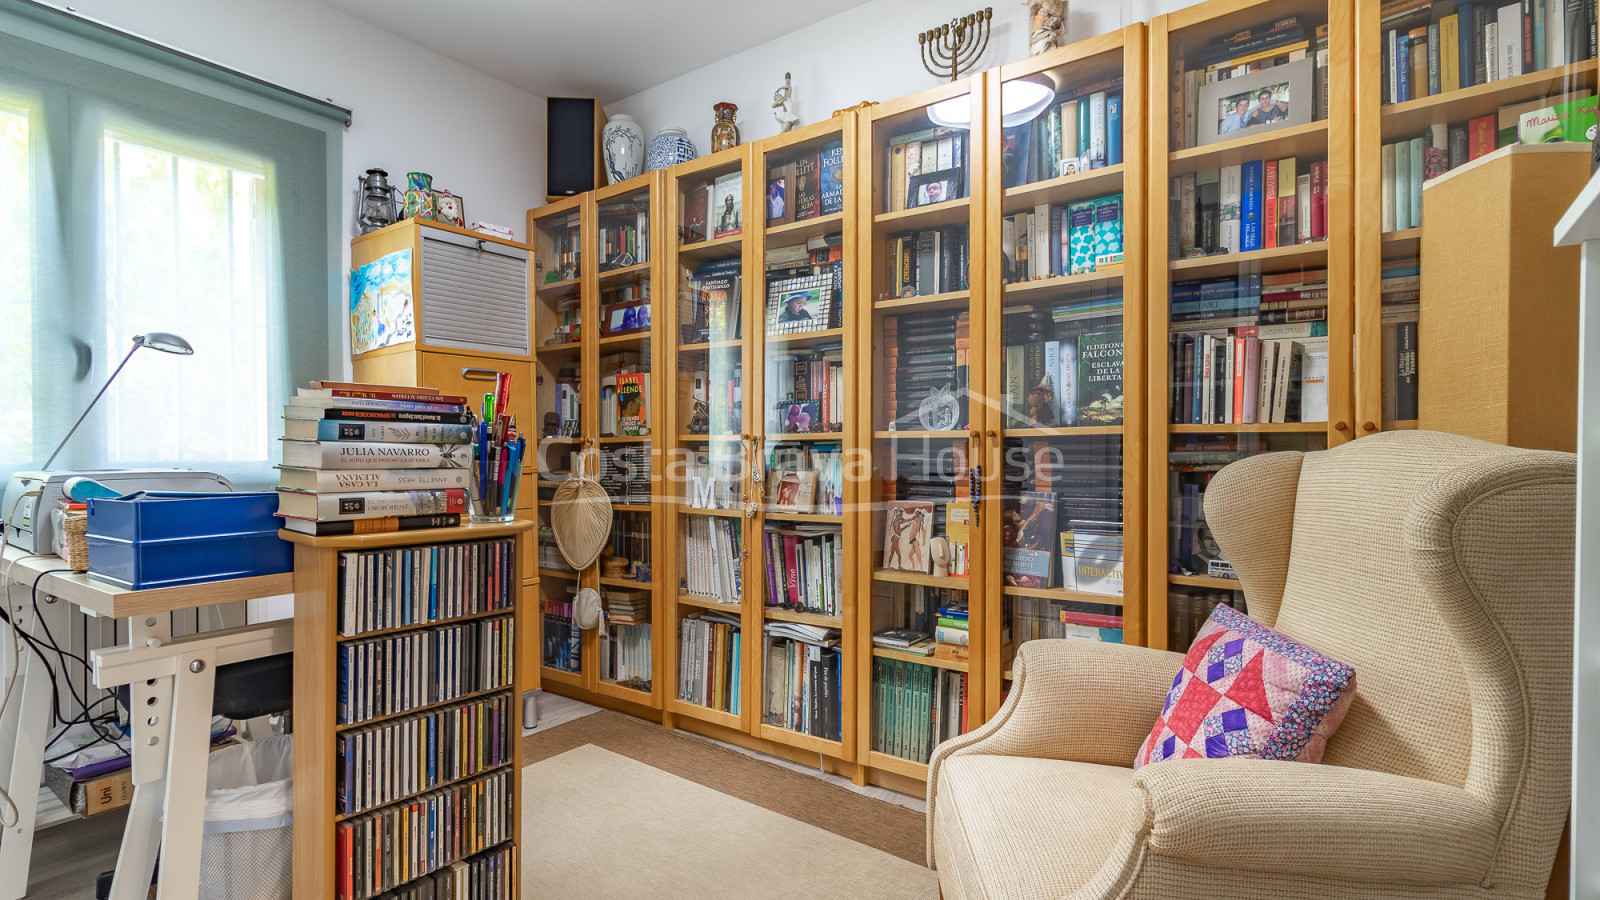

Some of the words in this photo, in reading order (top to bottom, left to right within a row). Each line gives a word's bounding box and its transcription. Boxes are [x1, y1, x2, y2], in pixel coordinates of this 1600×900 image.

[1526, 111, 1571, 128] Marian
[1578, 102, 1598, 117] Key
[824, 156, 843, 168] FOLL
[822, 188, 843, 200] ARMAD
[1082, 348, 1123, 359] FALCON
[619, 377, 639, 385] ISABEL
[617, 386, 643, 394] ALLENDE
[341, 448, 375, 456] JULIA
[378, 448, 430, 457] NAVARRO
[692, 477, 716, 509] M
[1078, 566, 1123, 579] INTERACTIV
[100, 786, 113, 805] Uni
